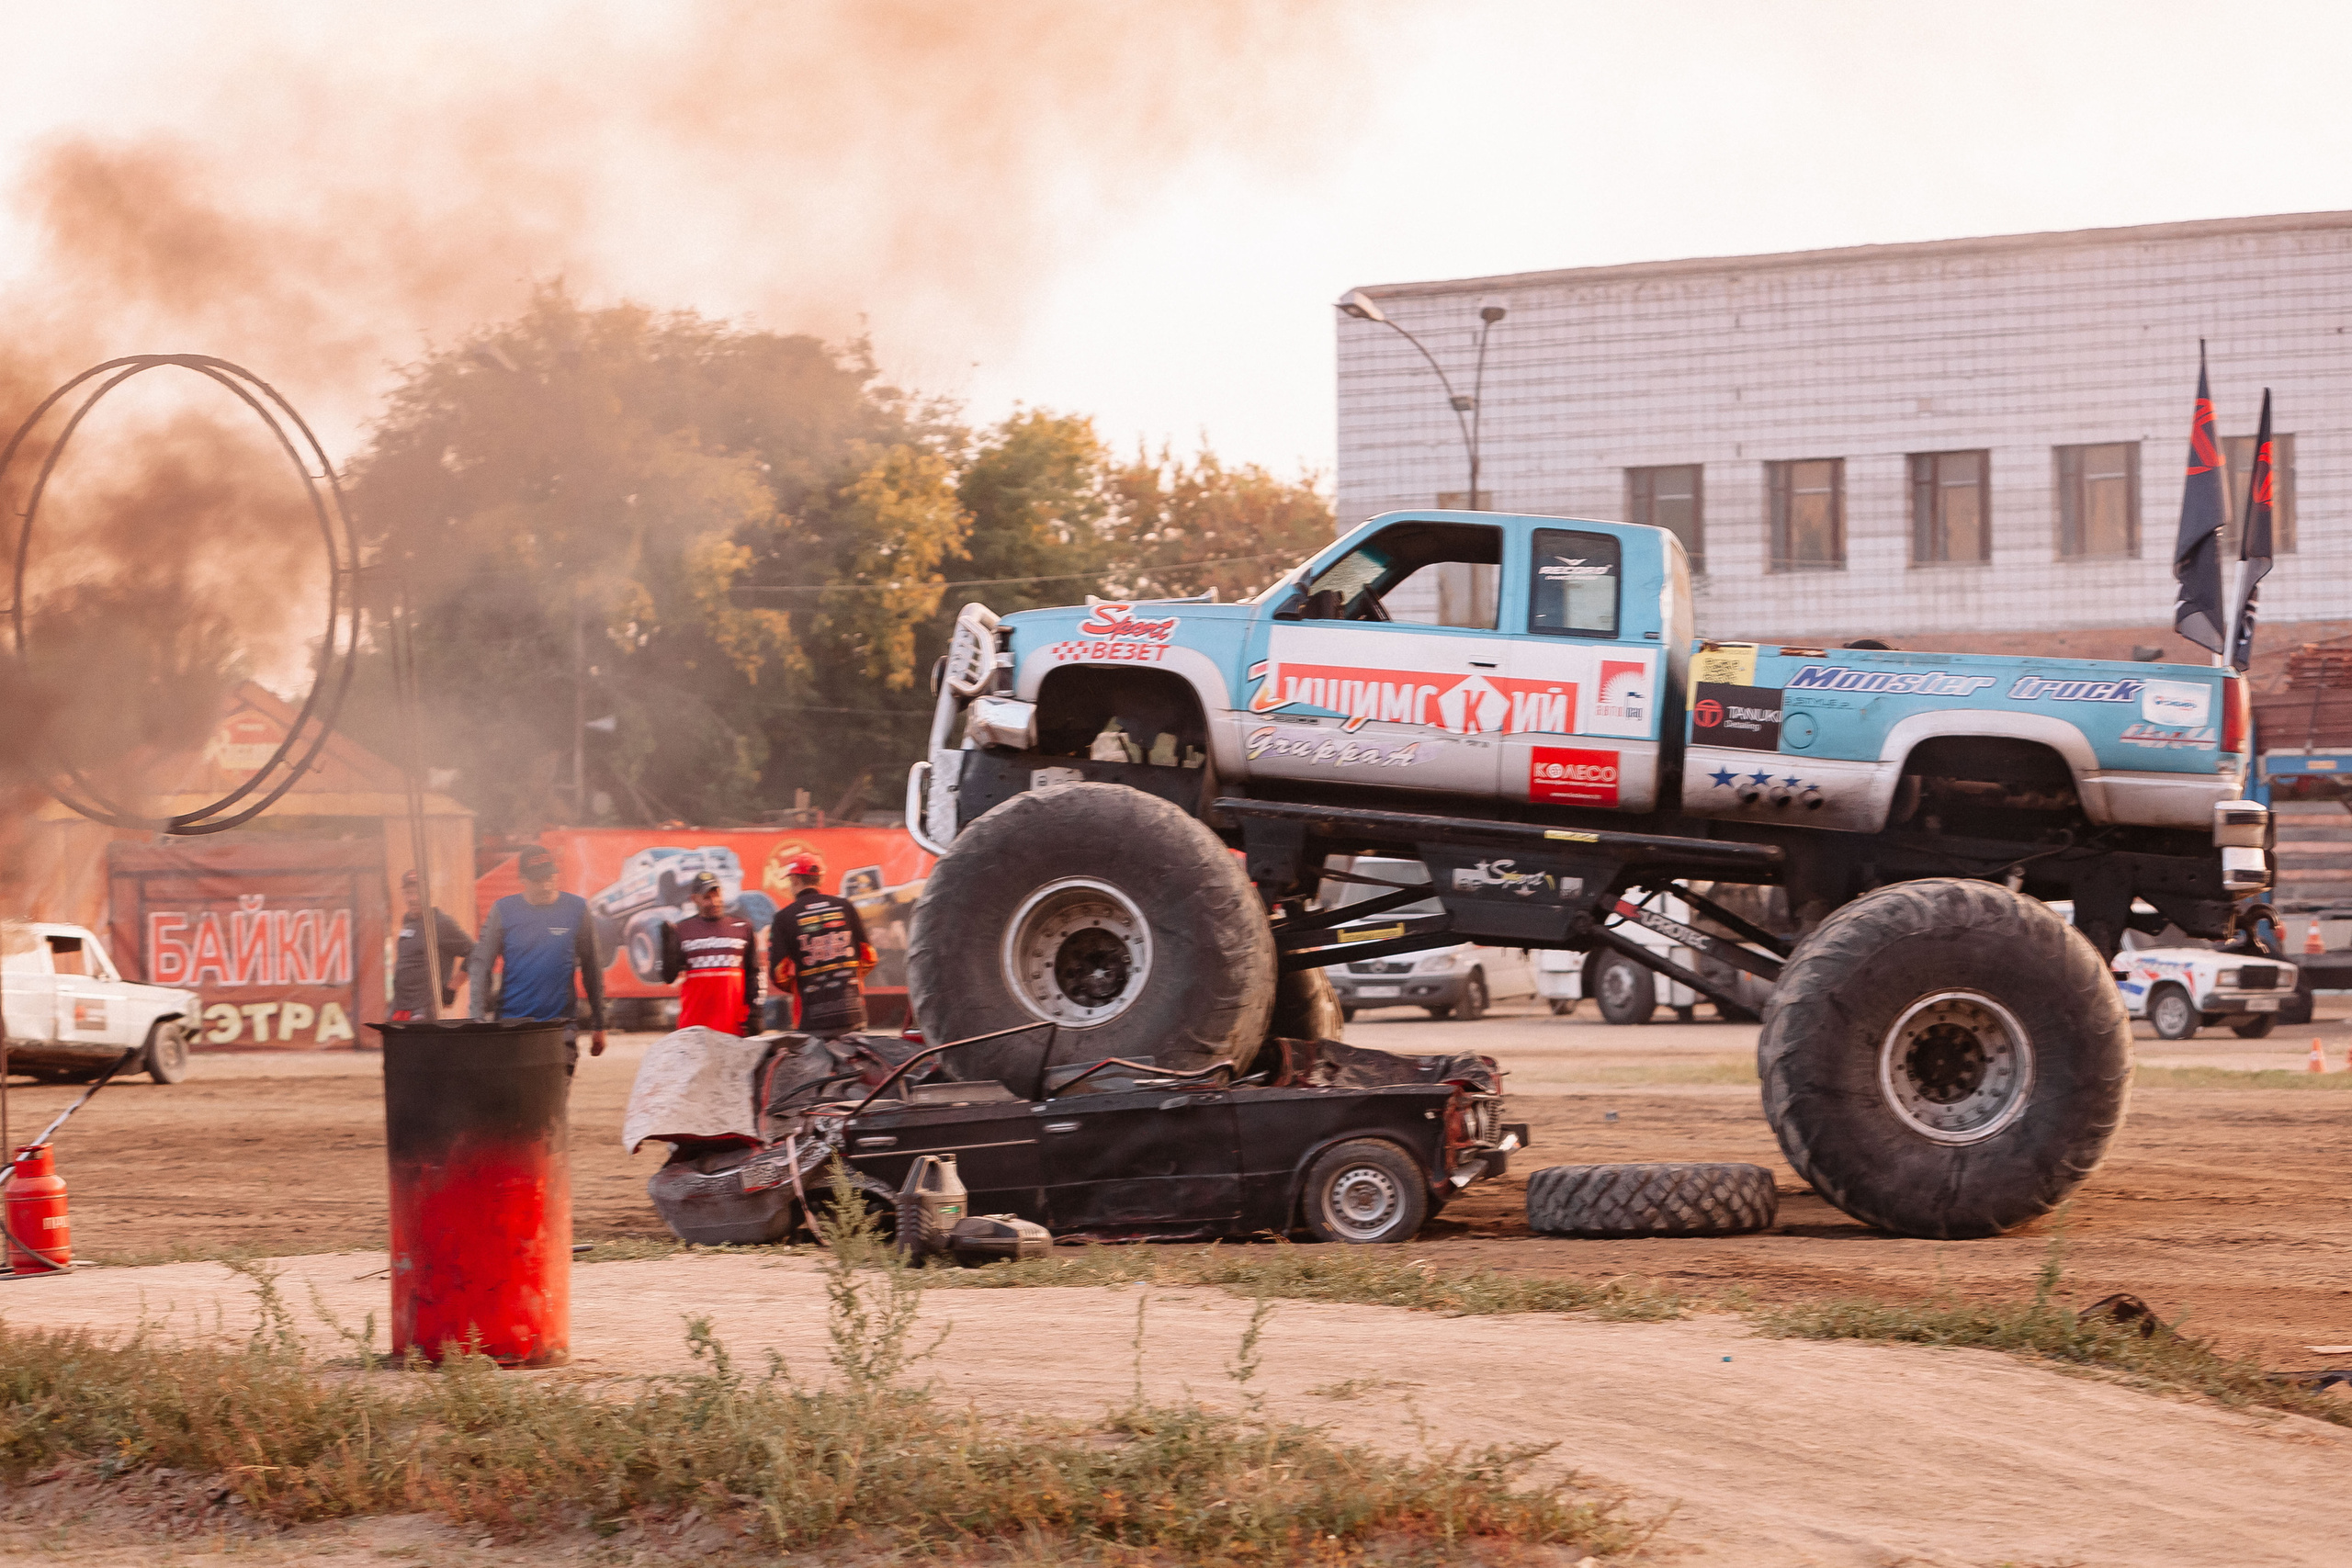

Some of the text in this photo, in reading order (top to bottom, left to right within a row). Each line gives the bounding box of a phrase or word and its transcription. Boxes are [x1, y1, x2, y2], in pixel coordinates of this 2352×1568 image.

[1082, 604, 1174, 641] Sport
[1091, 641, 1170, 661] ВЕЗЕТ
[1783, 665, 2146, 703] Monster truck
[1726, 705, 1781, 722] TANUKI
[1247, 727, 1382, 768] Gruppa
[149, 894, 353, 987] БАЙКИ
[189, 1001, 355, 1043] ЭТРА
